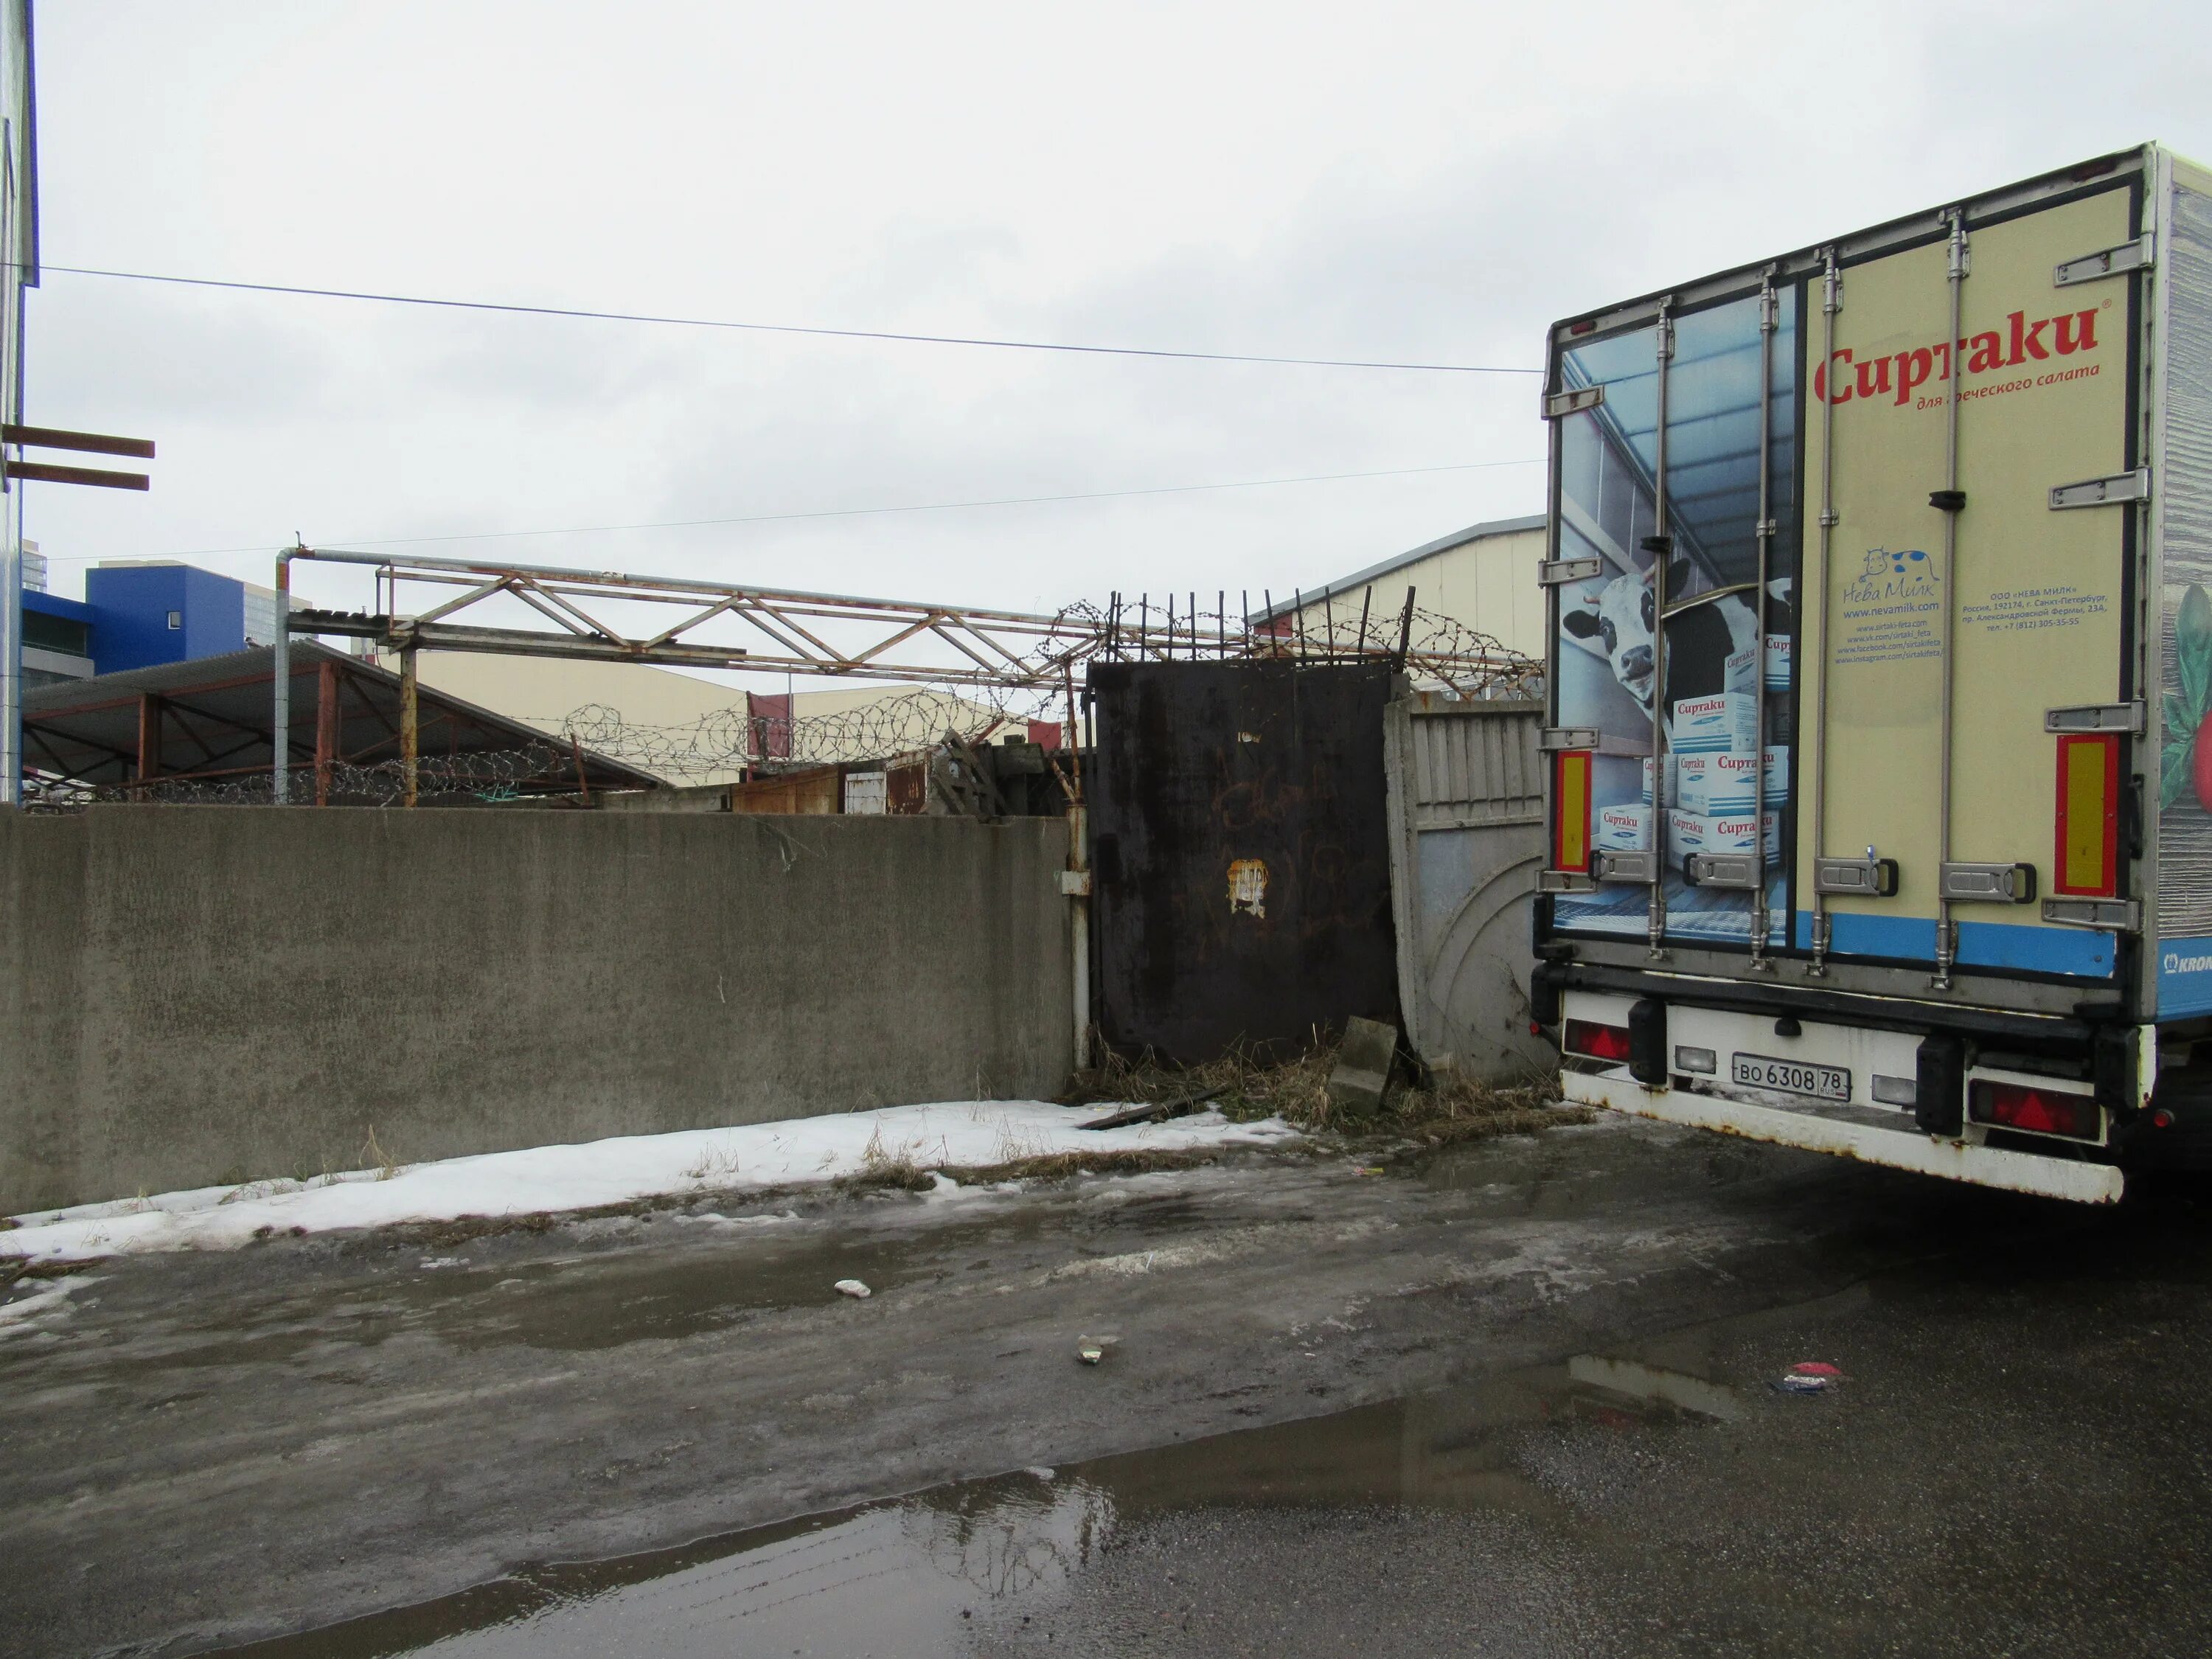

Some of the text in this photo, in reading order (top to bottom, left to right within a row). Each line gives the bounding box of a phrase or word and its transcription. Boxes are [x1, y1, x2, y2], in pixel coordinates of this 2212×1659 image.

[1917, 364, 2100, 411] для реческого салата
[1843, 577, 1935, 604] Нева Милк
[1991, 592, 2011, 601] ООО
[1843, 602, 1939, 619] www.nevamilk.com
[1963, 605, 1991, 613] Россия,
[1994, 601, 2024, 611] 192174,
[2034, 594, 2108, 608] Санкт-Петербург,
[1962, 616, 1975, 624] пр.
[1977, 609, 2049, 622] Александровской
[2051, 606, 2085, 616] Фермы,
[1856, 619, 1927, 633] www.sirtaki-feta.com
[2016, 621, 2037, 630] (812)
[2038, 618, 2079, 627] 305-35-55
[1846, 630, 1931, 644] www.vk.com/sirtaki_feta
[1766, 637, 1790, 653] Сир
[1837, 639, 1941, 654] www.facebook.com/sirtakifeta
[1727, 648, 1756, 668] Сиртаки
[1677, 700, 1725, 715] Сиртаки
[1680, 758, 1705, 770] Сиртаки
[1604, 812, 1638, 827] Сиртаки
[1672, 815, 1704, 835] Сиртаки
[1740, 1064, 1841, 1090] ВО 6308 78
[1820, 1087, 1836, 1095] RUS
